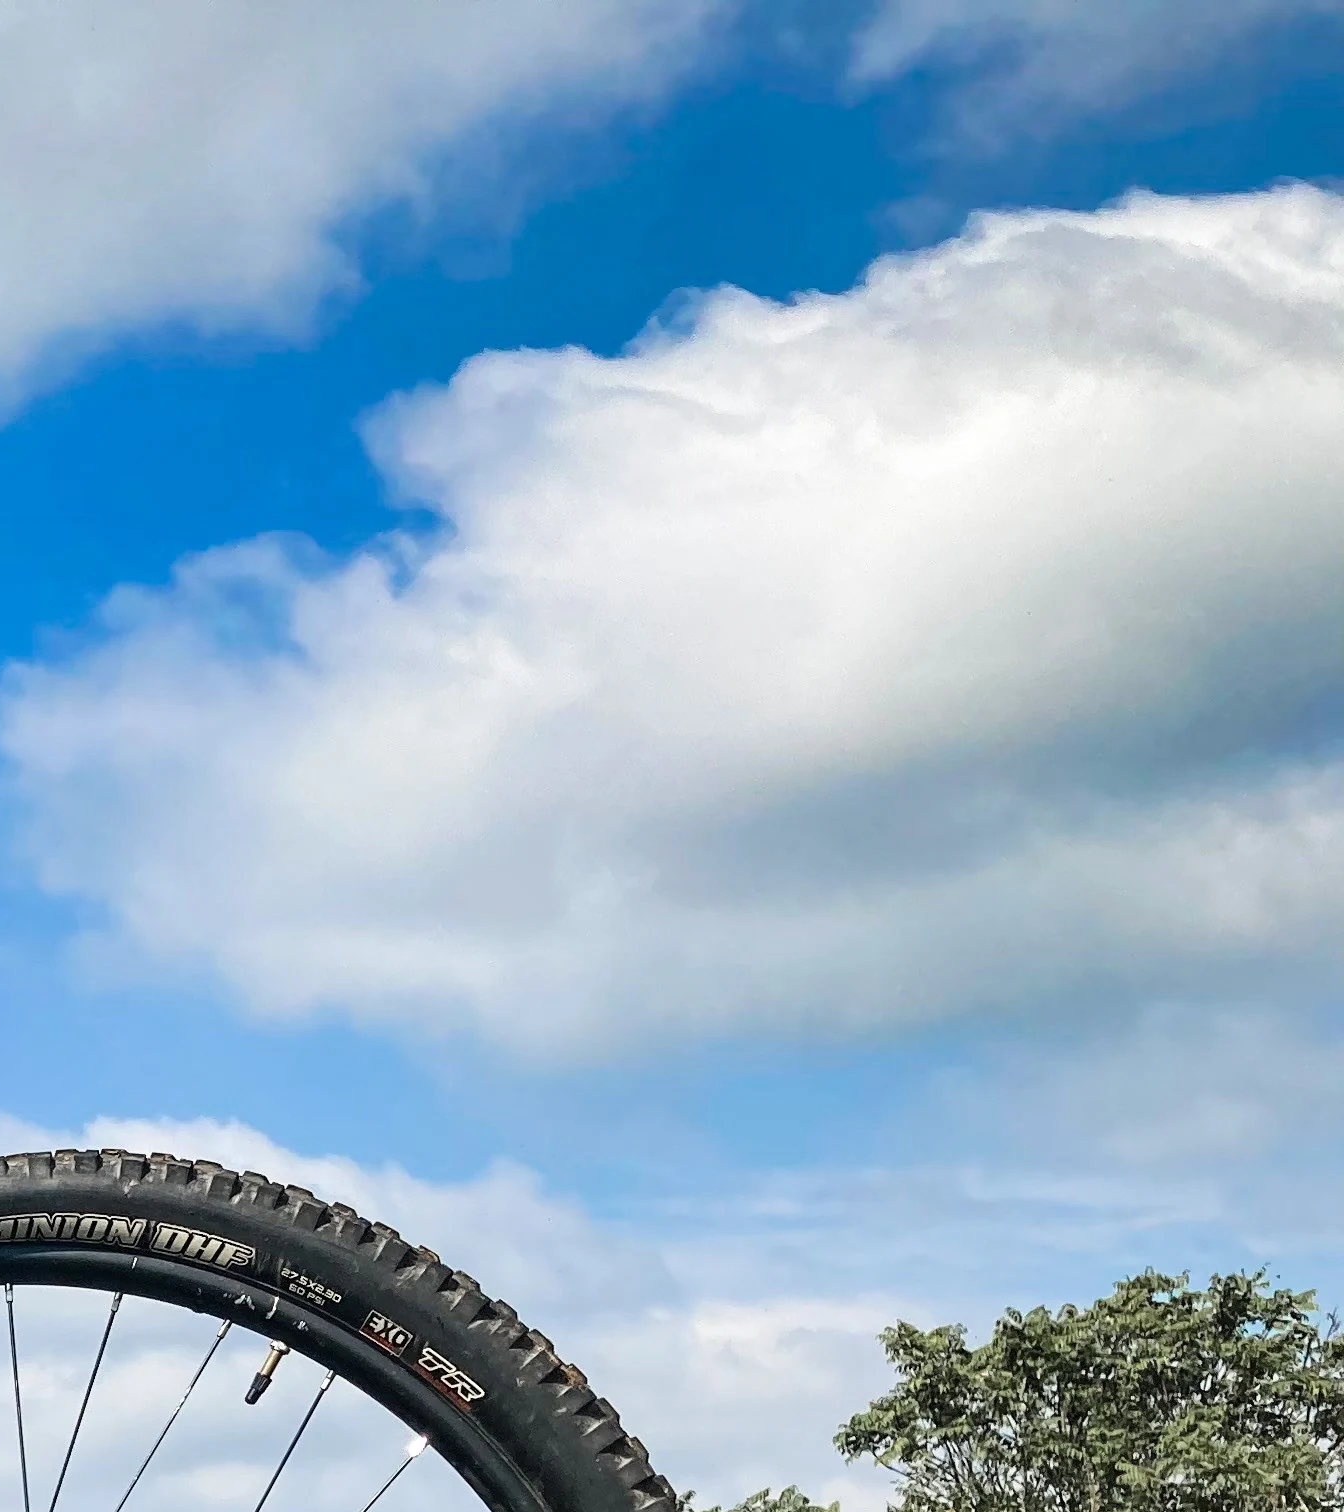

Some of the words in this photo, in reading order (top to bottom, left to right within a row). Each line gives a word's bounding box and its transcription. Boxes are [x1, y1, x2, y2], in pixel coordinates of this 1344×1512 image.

[150, 1222, 257, 1270] DHF
[368, 1314, 410, 1349] EXO
[418, 1347, 485, 1402] TR
